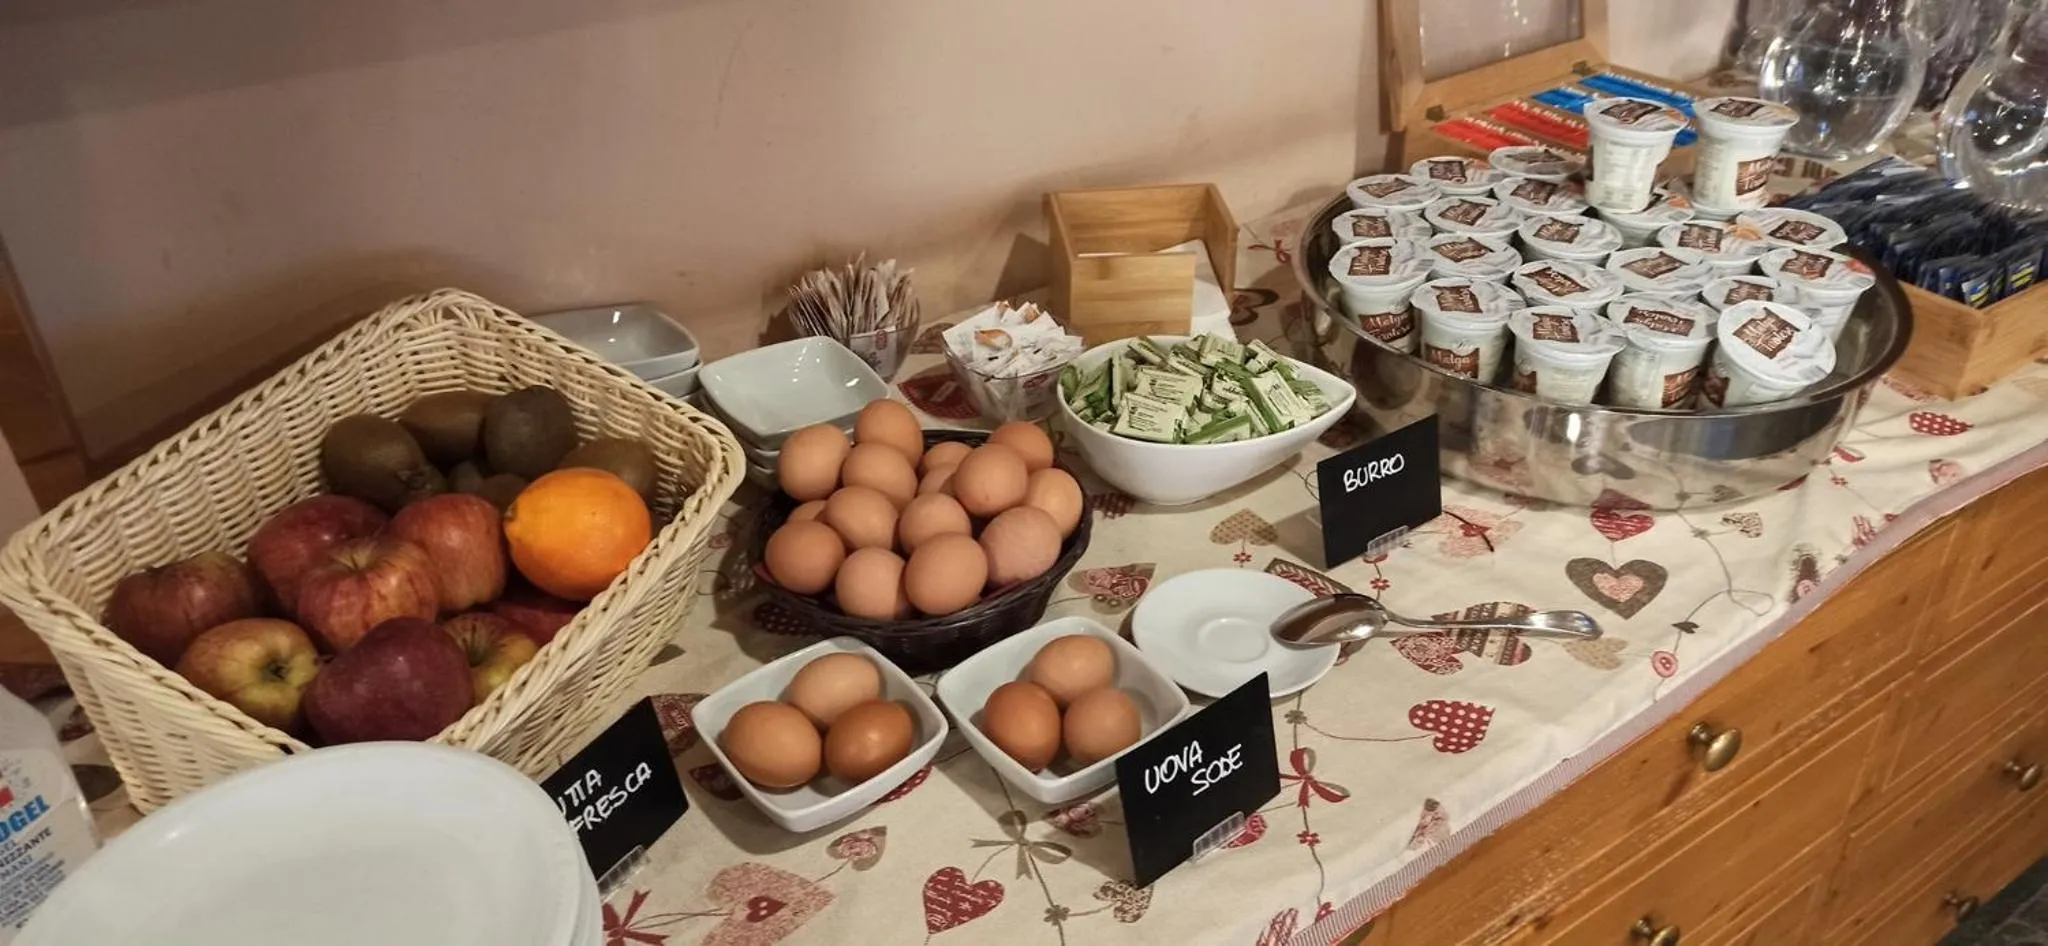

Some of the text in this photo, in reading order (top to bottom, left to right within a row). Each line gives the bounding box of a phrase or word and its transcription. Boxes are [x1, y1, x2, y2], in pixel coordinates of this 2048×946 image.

[1343, 453, 1405, 493] BURRO
[1144, 740, 1203, 795] UOVA
[1191, 744, 1243, 796] SODE
